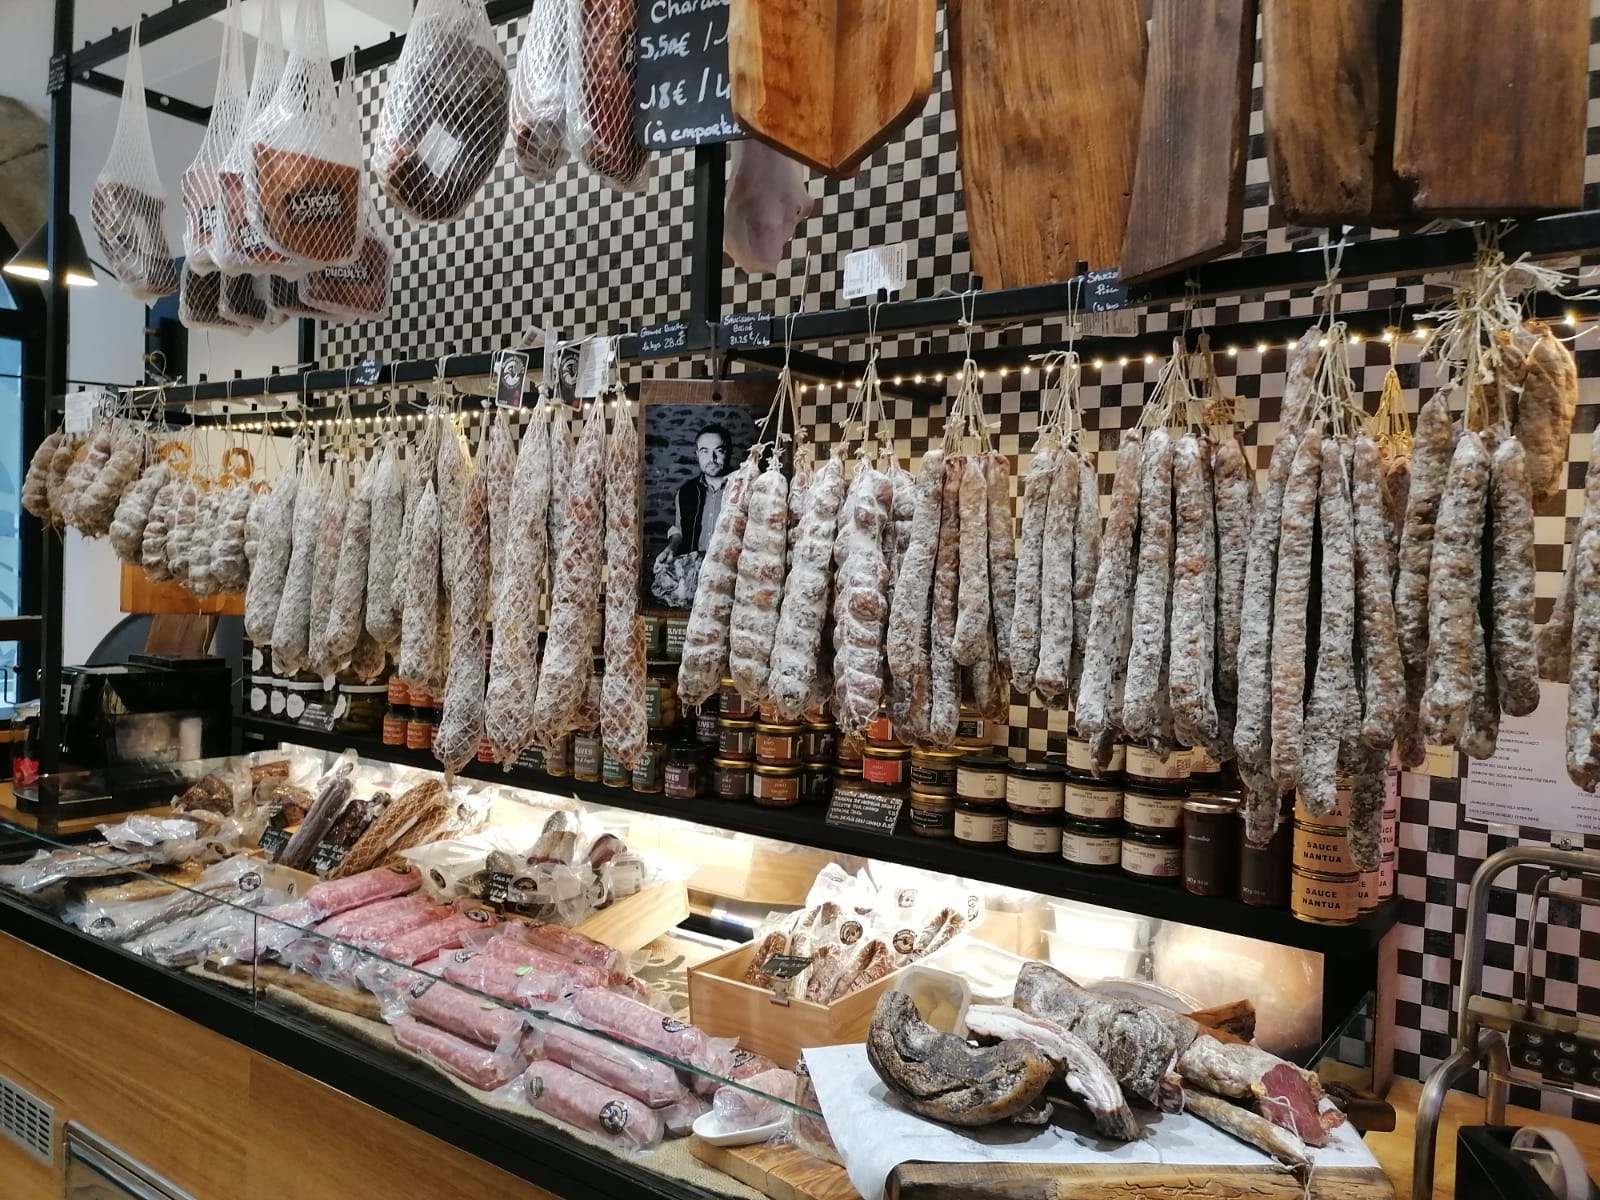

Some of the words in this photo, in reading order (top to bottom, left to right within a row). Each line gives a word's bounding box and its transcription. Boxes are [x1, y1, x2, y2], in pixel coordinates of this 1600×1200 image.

[639, 79, 688, 110] 18€
[1307, 842, 1339, 852] SAUCE
[1303, 852, 1342, 863] NANTUA
[1305, 888, 1338, 899] SAUCE
[1302, 898, 1341, 910] NANTUA
